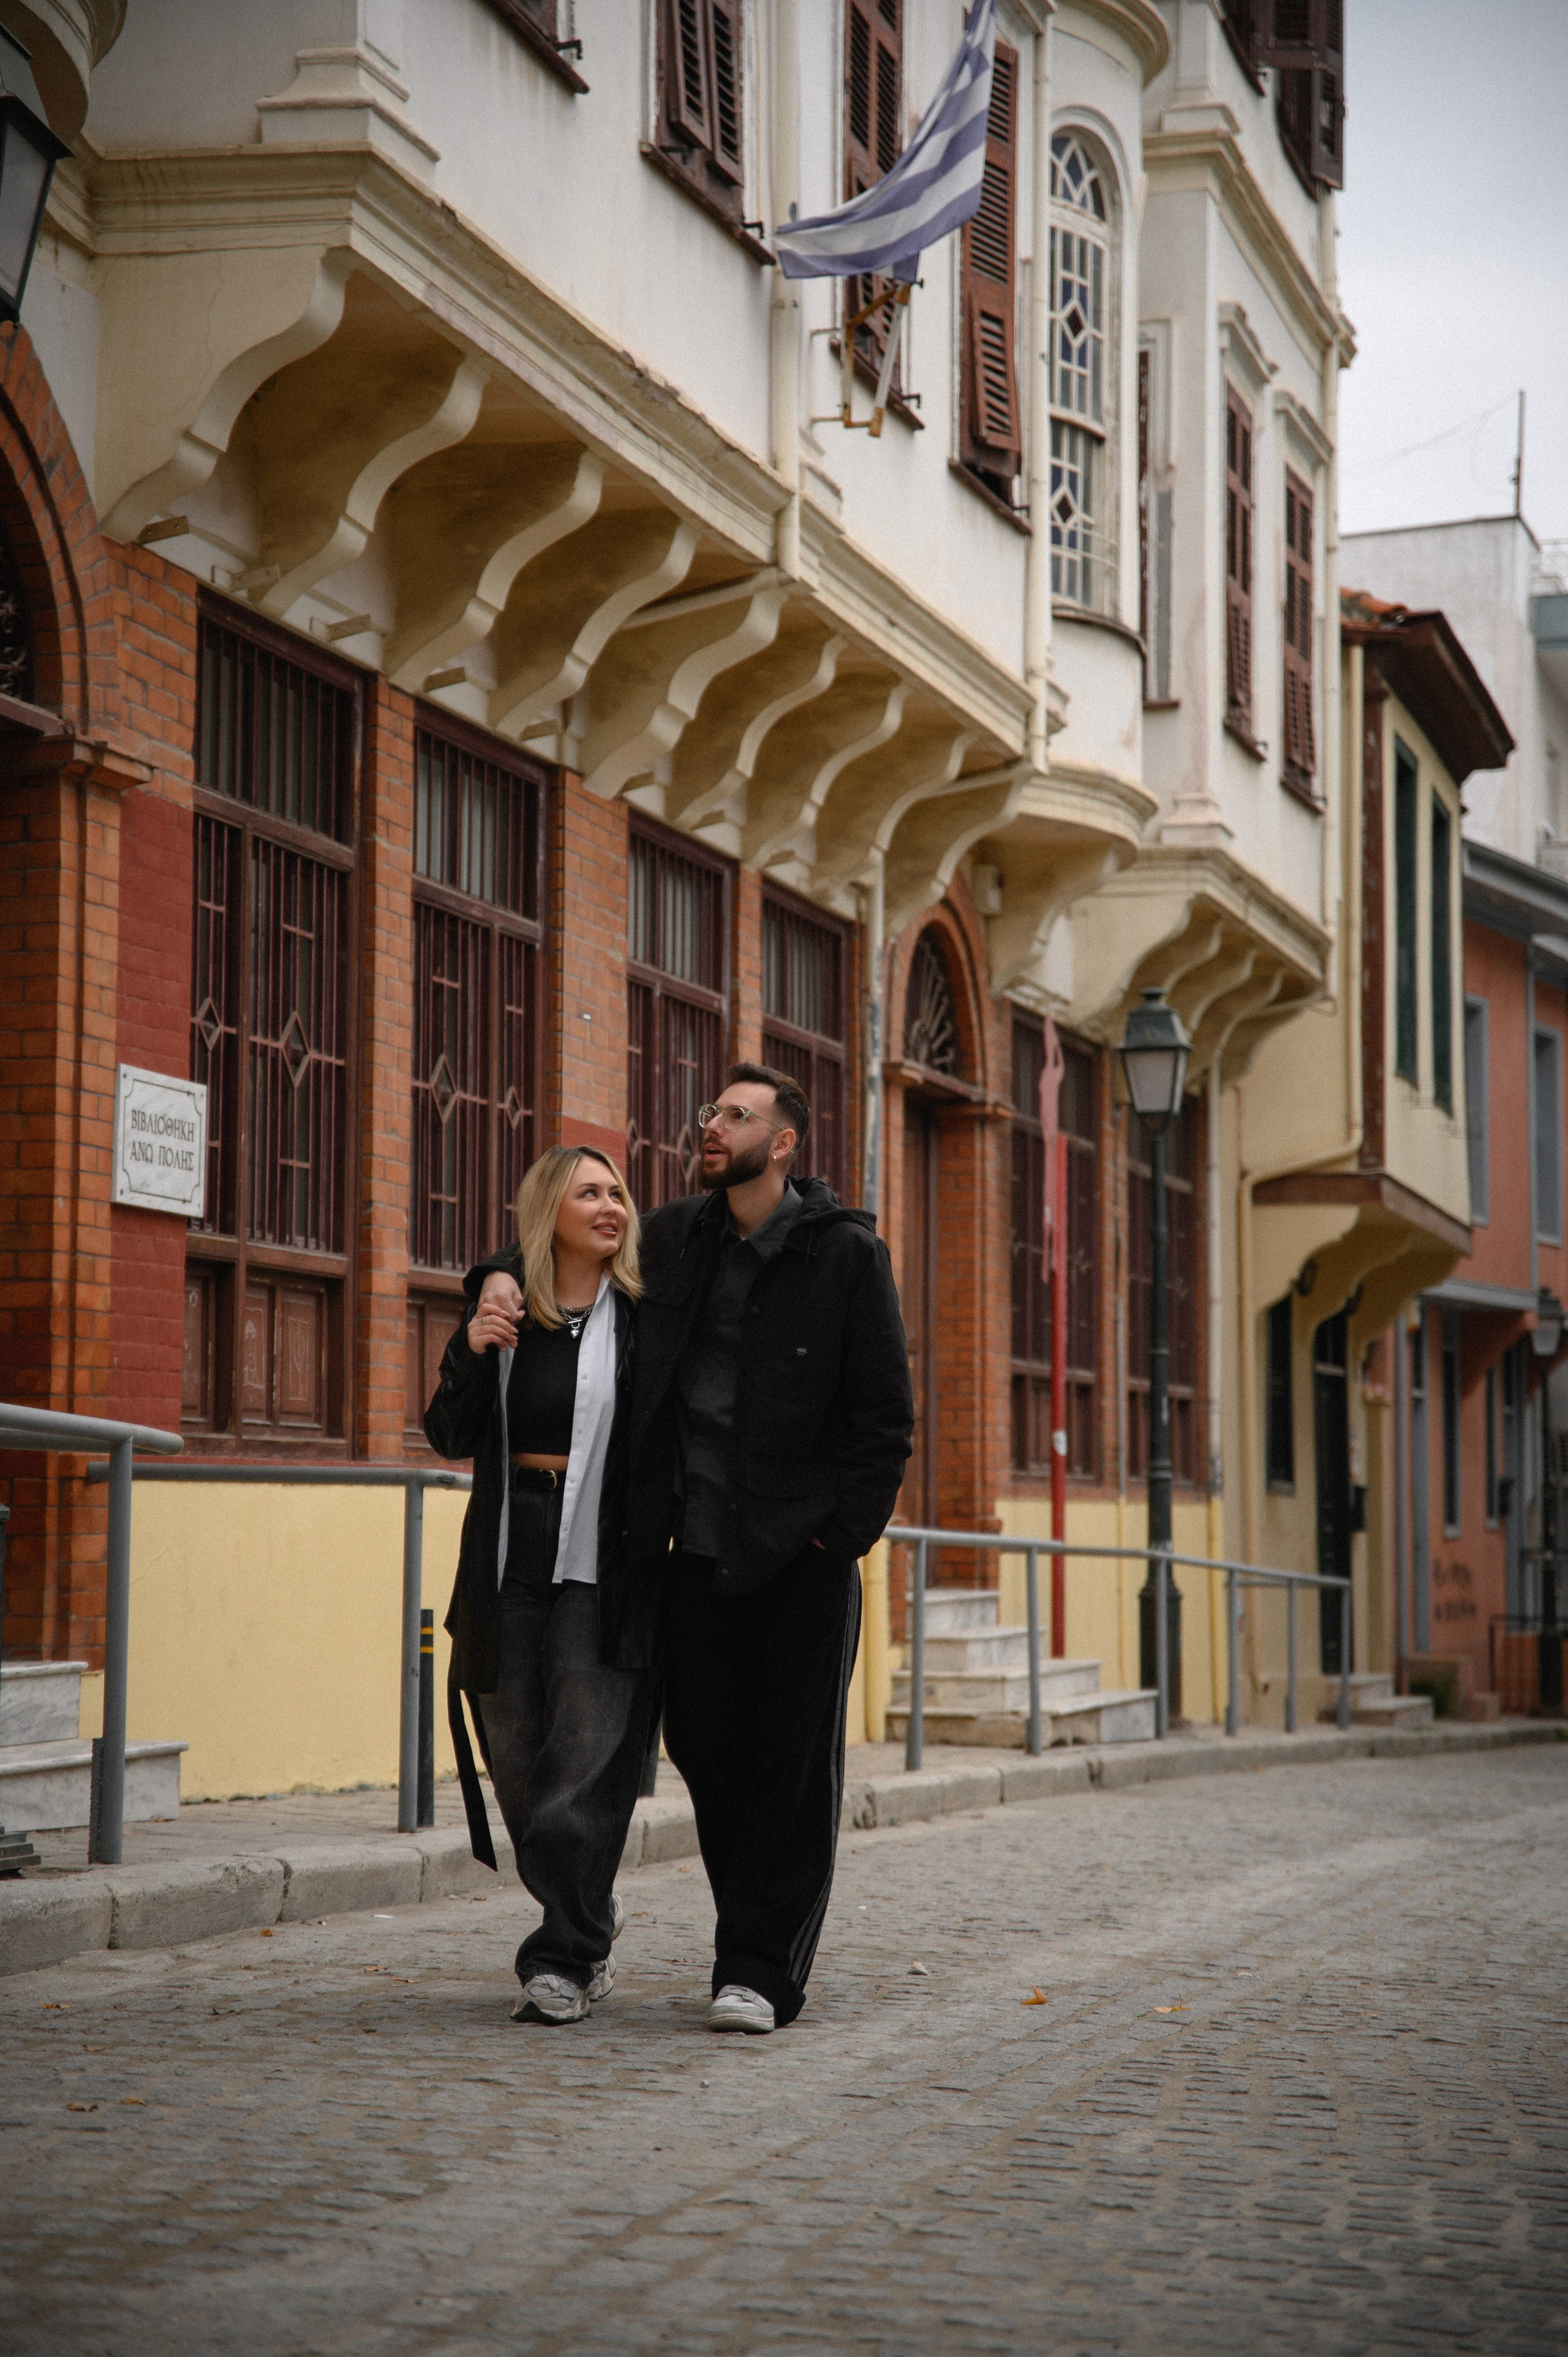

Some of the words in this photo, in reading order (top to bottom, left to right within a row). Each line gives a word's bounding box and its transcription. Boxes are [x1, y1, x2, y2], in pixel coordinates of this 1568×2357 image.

[130, 1109, 195, 1142] ΒΙΒΛΙΟΘΗΚΗ
[130, 1141, 153, 1163] ΑΝΩ
[158, 1145, 194, 1171] ΠΟΛΗΣ
